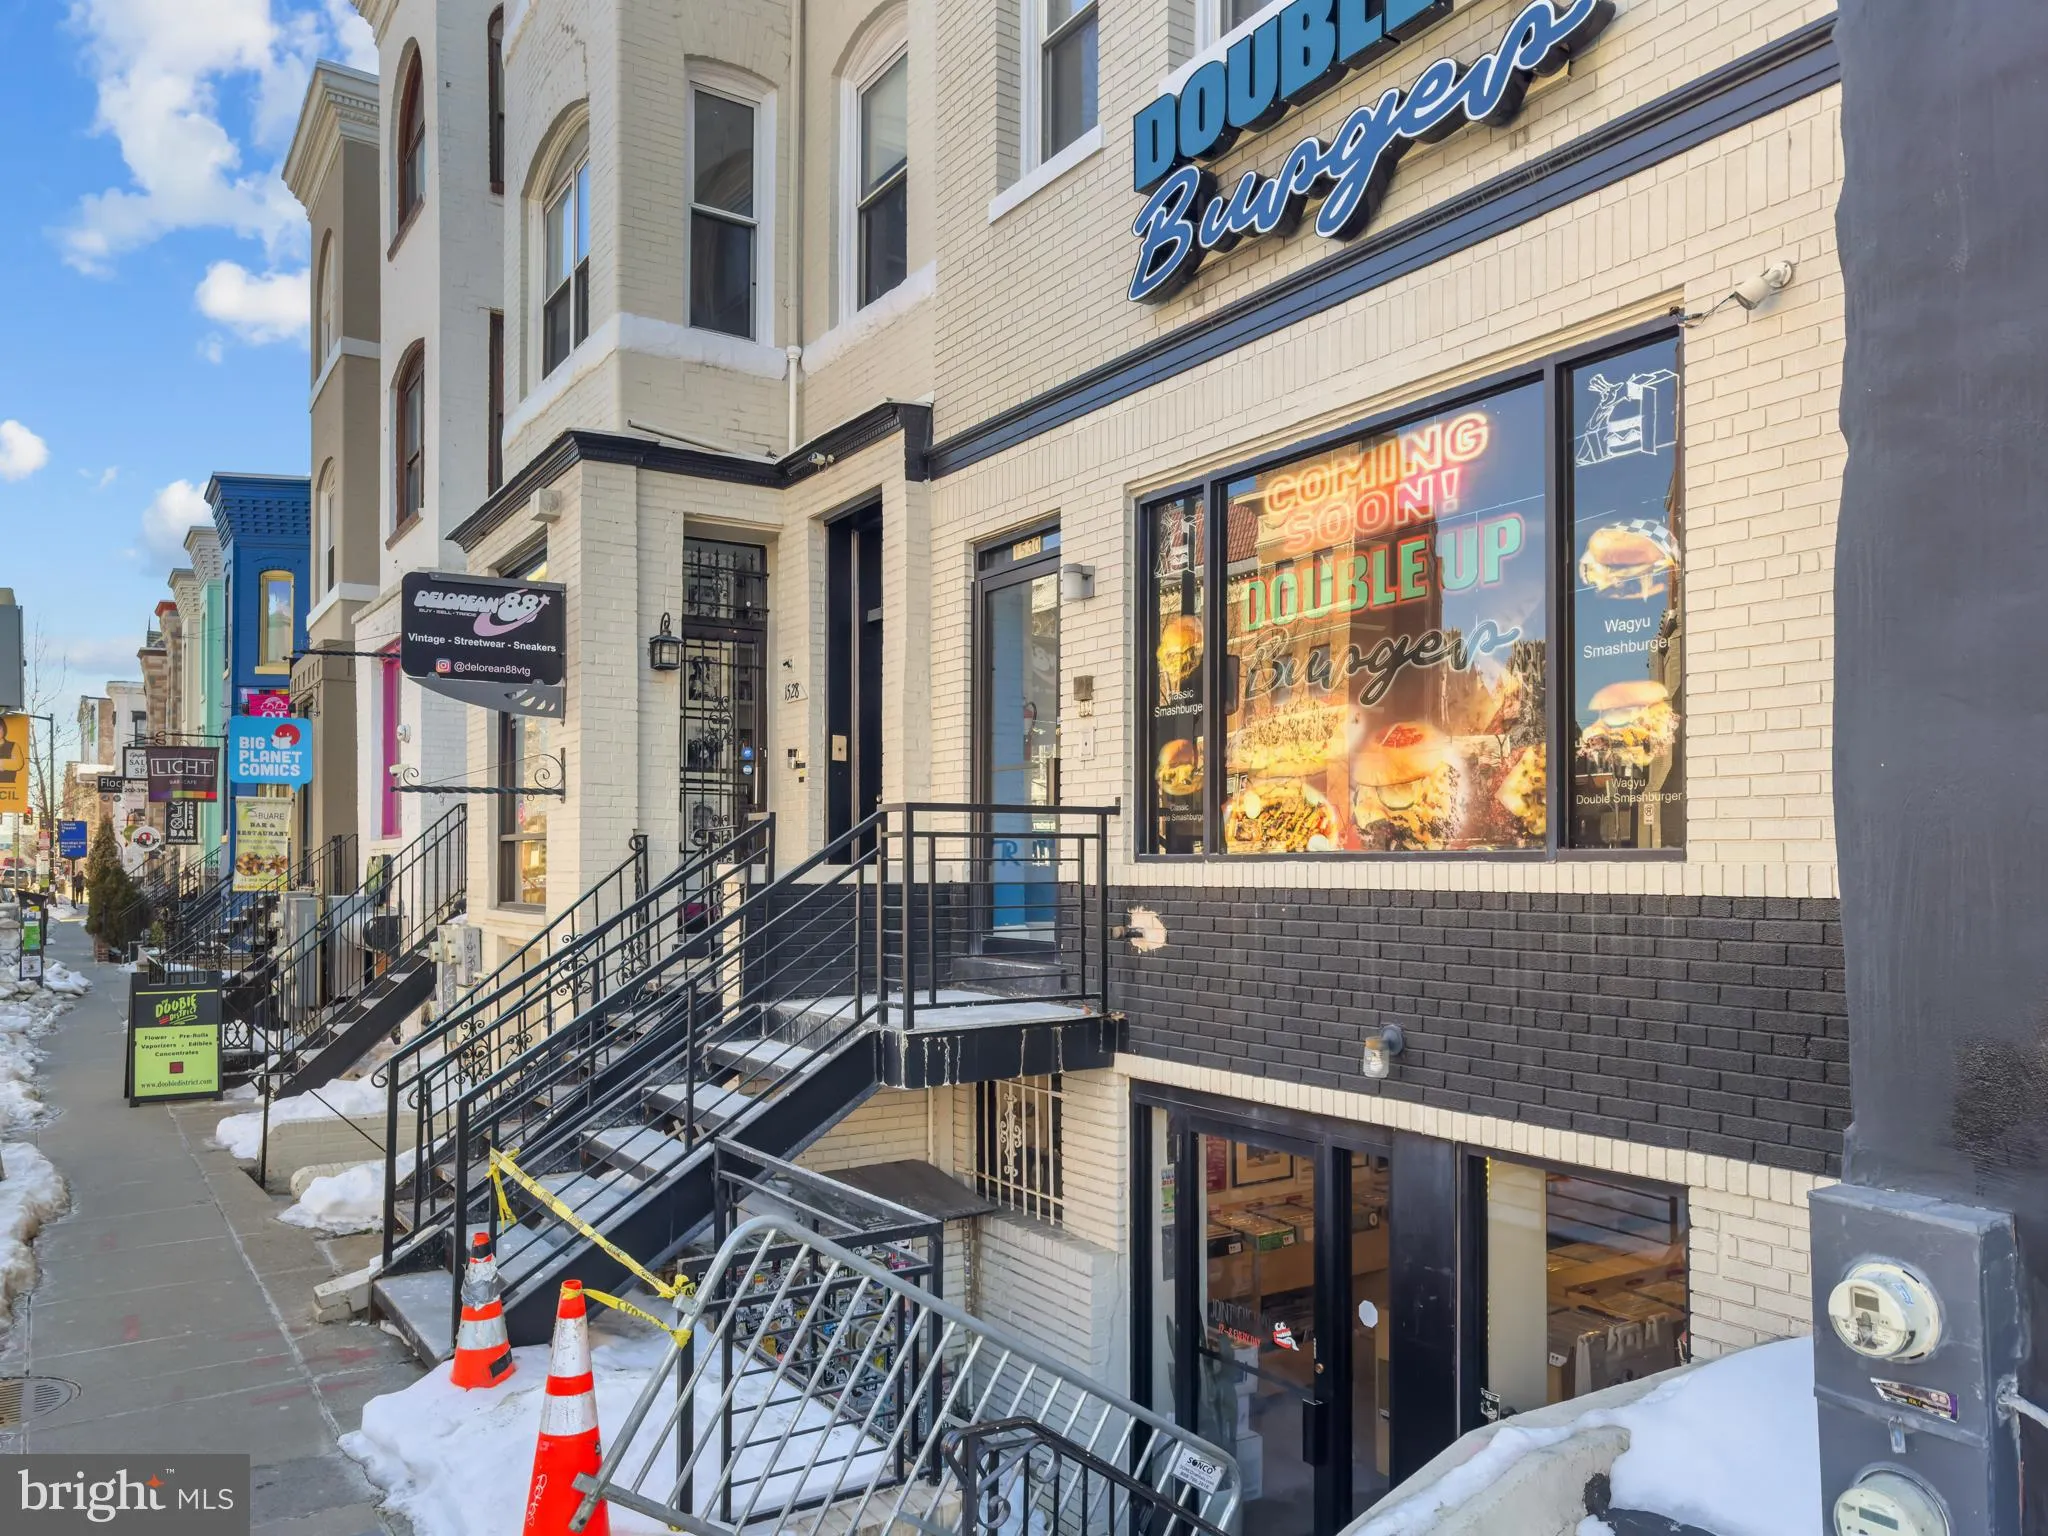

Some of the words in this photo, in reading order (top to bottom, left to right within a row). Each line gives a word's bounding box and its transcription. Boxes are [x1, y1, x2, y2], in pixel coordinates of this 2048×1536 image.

[1263, 411, 1489, 517] COMING
[1284, 467, 1460, 553] SOON!
[1241, 534, 1431, 632] DOUBLE
[1437, 513, 1525, 594] UP
[414, 590, 499, 613] DELOREAN
[1605, 616, 1651, 634] Wagyu
[408, 632, 446, 645] Vintage
[454, 636, 506, 649] Streetwear
[513, 641, 557, 652] Sneakers
[1583, 636, 1671, 659] Smashburger
[454, 661, 531, 677] @delorean88vtg
[1245, 618, 1522, 707] Burgers
[784, 682, 800, 700] 1528
[1154, 702, 1203, 718] Smashburge
[239, 736, 266, 749] BIG
[239, 750, 302, 763] PLANET
[156, 761, 210, 774] LICHT
[239, 763, 301, 776] COMICS
[1611, 777, 1646, 789] Wagyu
[1576, 794, 1610, 805] Double
[1613, 792, 1682, 804] Smashburger
[155, 993, 197, 1018] DOOBIE
[169, 1006, 197, 1021] DISTRICT
[141, 1079, 213, 1088] www.doobiedistrict.com
[1187, 1456, 1214, 1475] SONCO
